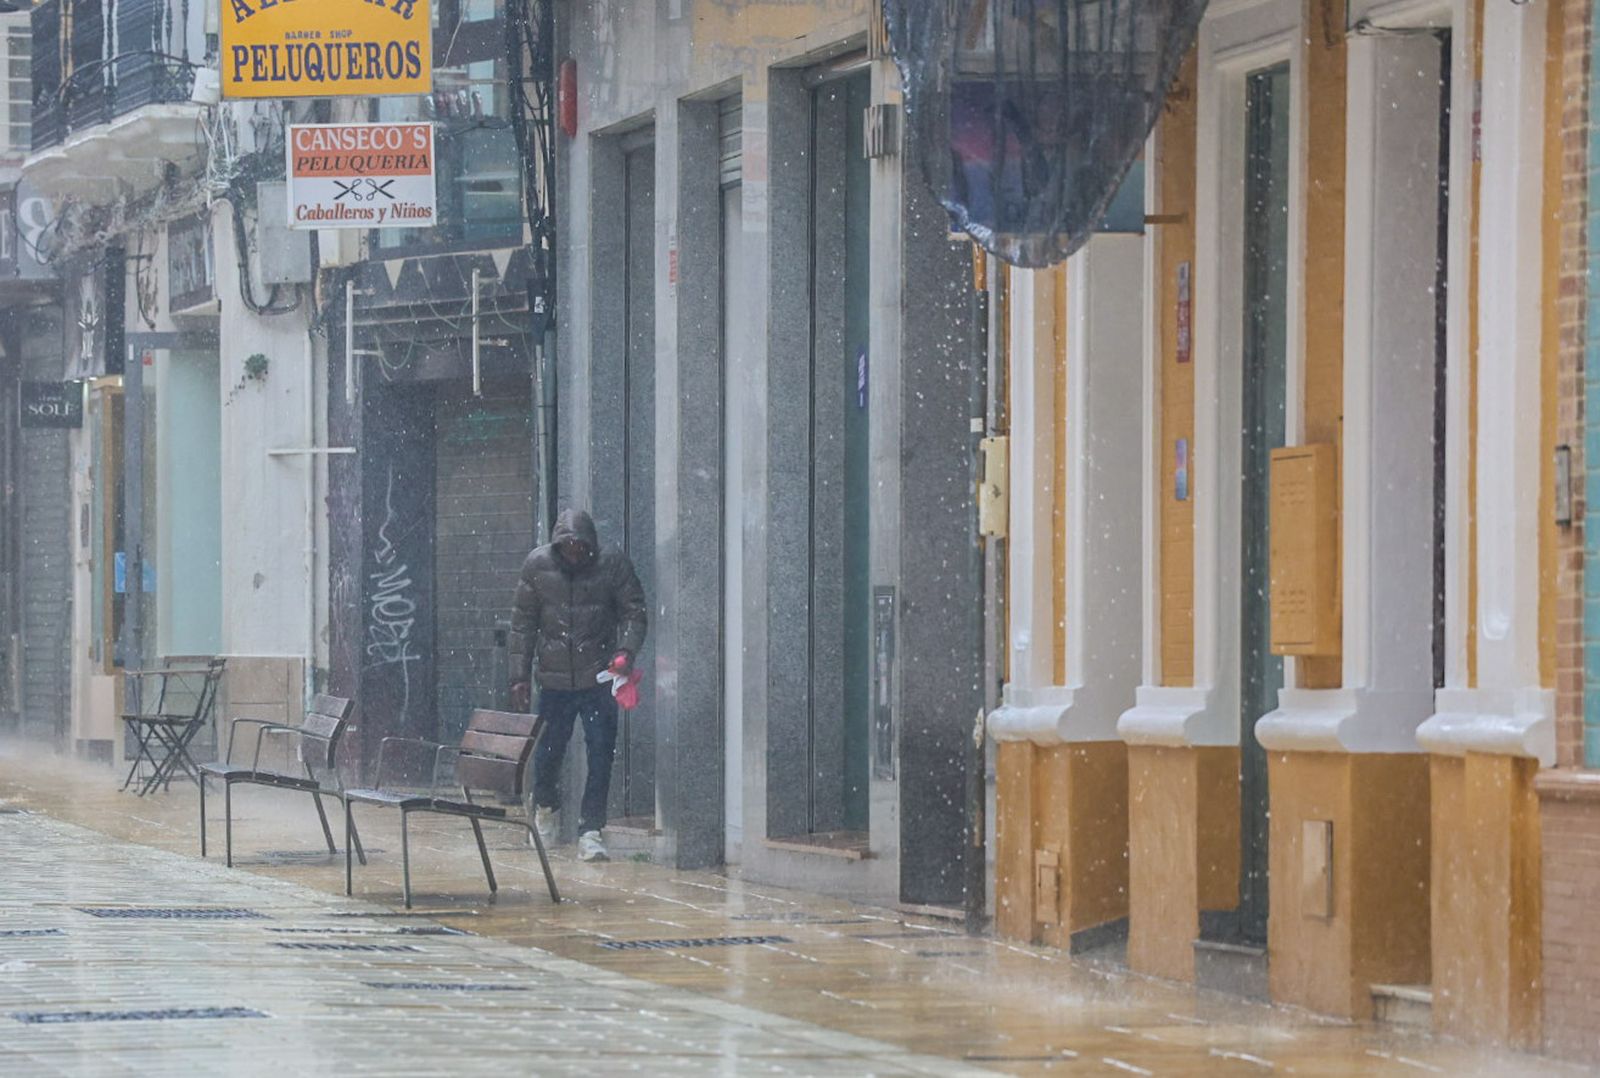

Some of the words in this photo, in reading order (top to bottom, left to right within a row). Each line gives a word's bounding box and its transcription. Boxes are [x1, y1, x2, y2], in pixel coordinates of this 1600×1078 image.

[330, 29, 353, 39] SHOP
[232, 41, 421, 82] PELUQUEROS
[296, 154, 429, 174] PELUQUERIA
[296, 202, 374, 222] Caballeros
[376, 207, 388, 224] y
[390, 202, 432, 219] Niños
